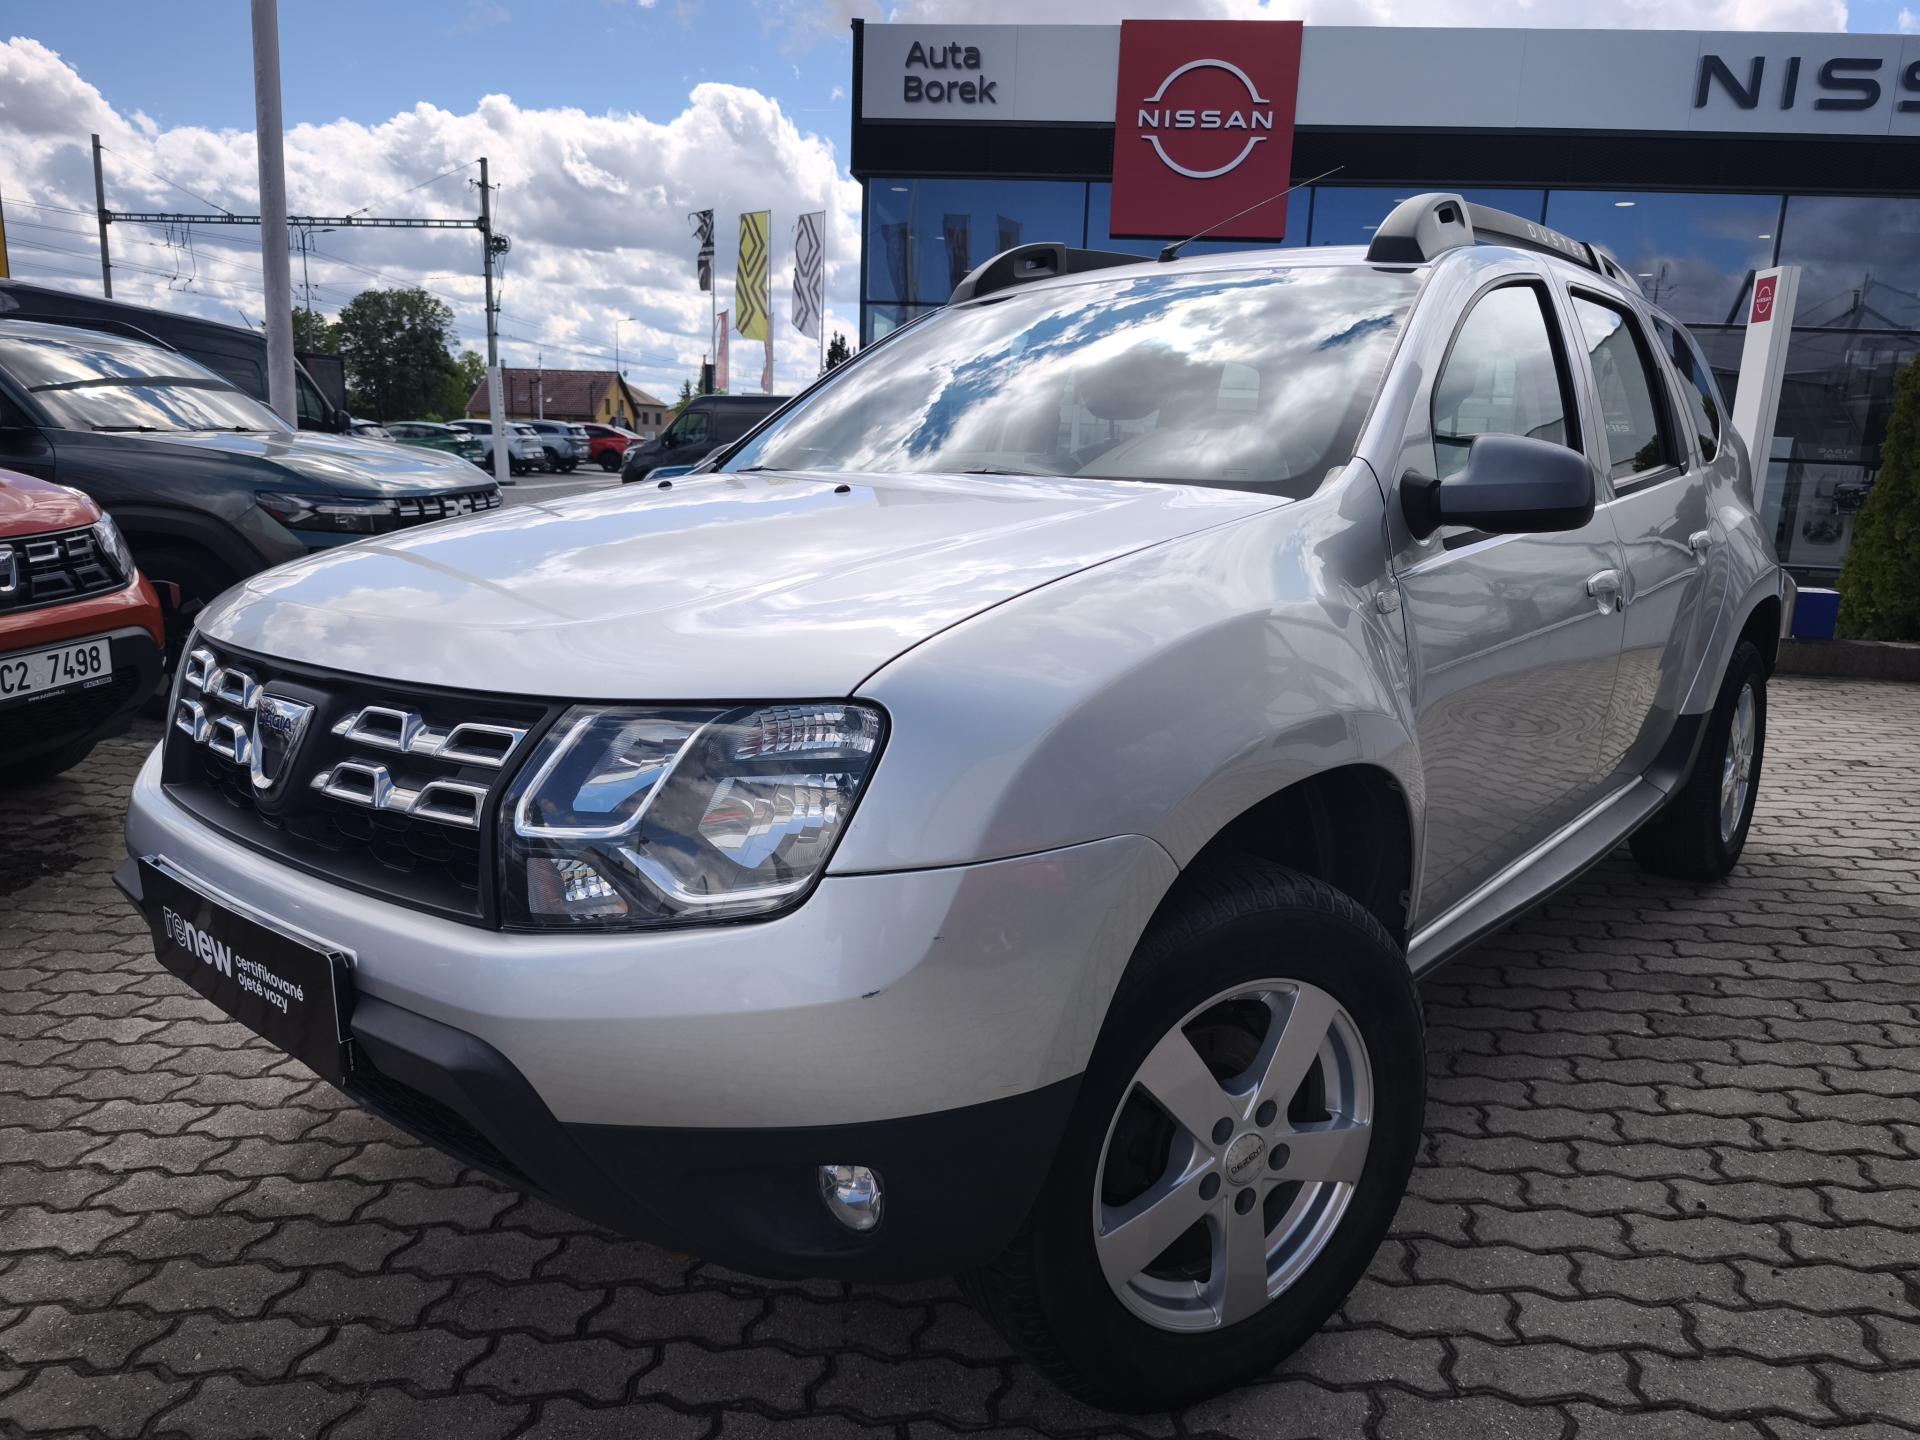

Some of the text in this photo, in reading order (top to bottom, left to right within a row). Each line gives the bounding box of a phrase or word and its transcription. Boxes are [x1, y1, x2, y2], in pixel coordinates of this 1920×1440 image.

[905, 41, 981, 69] Auta
[904, 75, 997, 104] Borek
[1138, 109, 1273, 130] NISSAN
[1527, 223, 1588, 260] DUSTER
[0, 645, 102, 694] C2 7498
[163, 905, 232, 978] renew
[236, 955, 304, 1002] certifikované
[238, 973, 288, 1014] ojeté vozy
